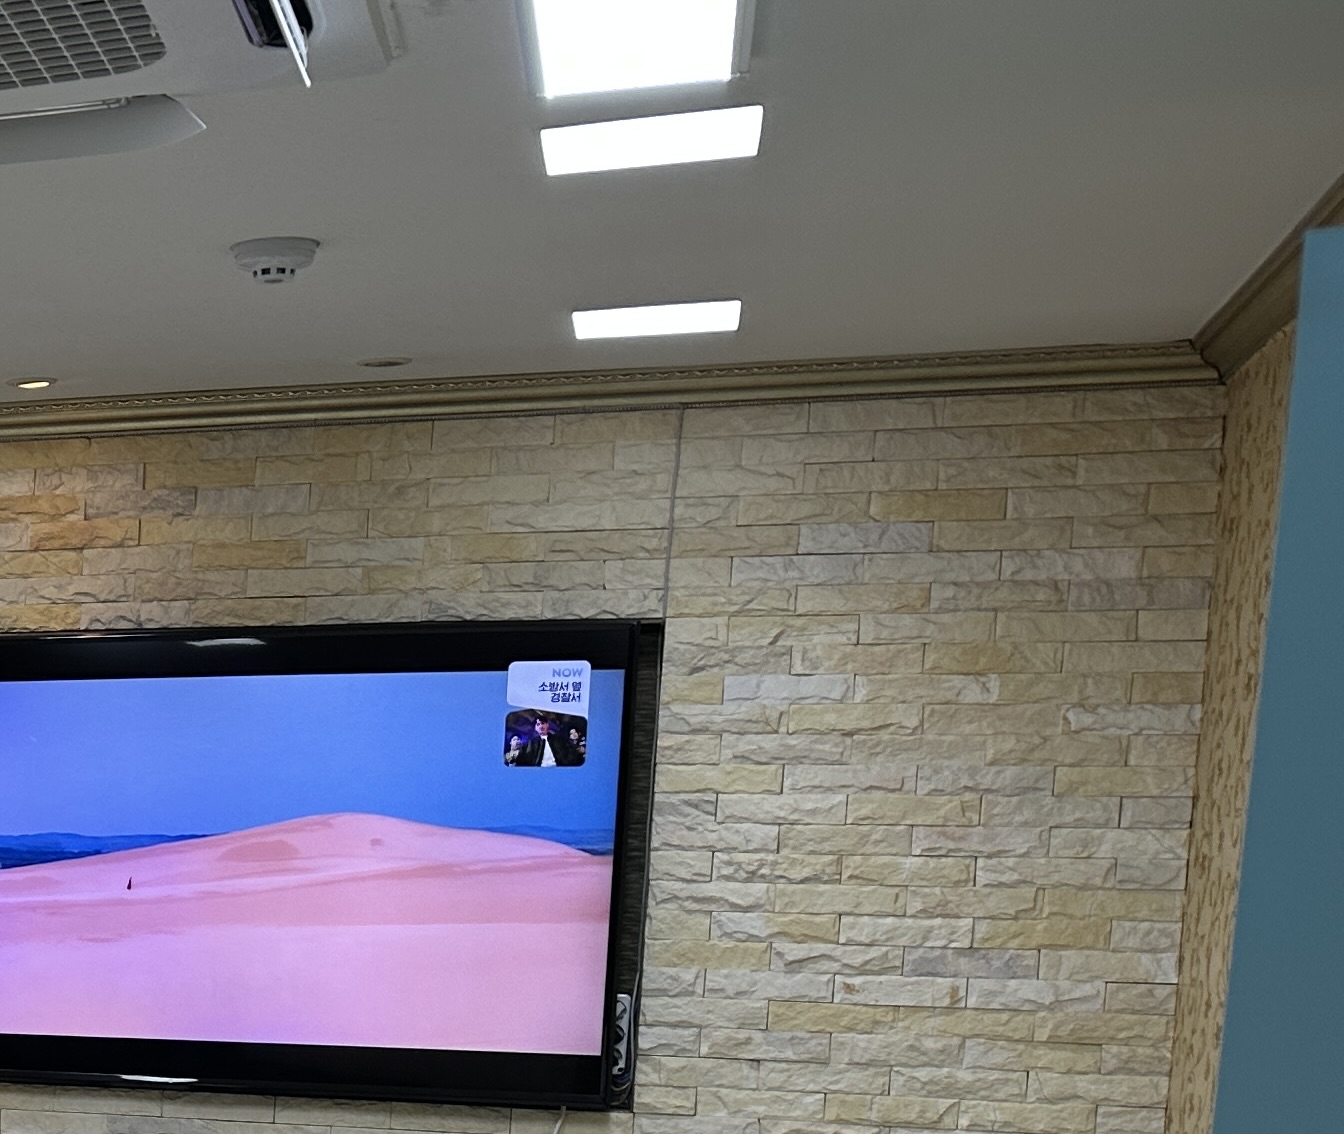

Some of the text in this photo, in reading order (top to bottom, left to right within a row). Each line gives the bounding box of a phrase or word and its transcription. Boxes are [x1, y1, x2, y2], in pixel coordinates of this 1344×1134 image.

[552, 668, 583, 678] NOW
[538, 681, 569, 692] 소방서
[551, 692, 581, 703] 경찰서
